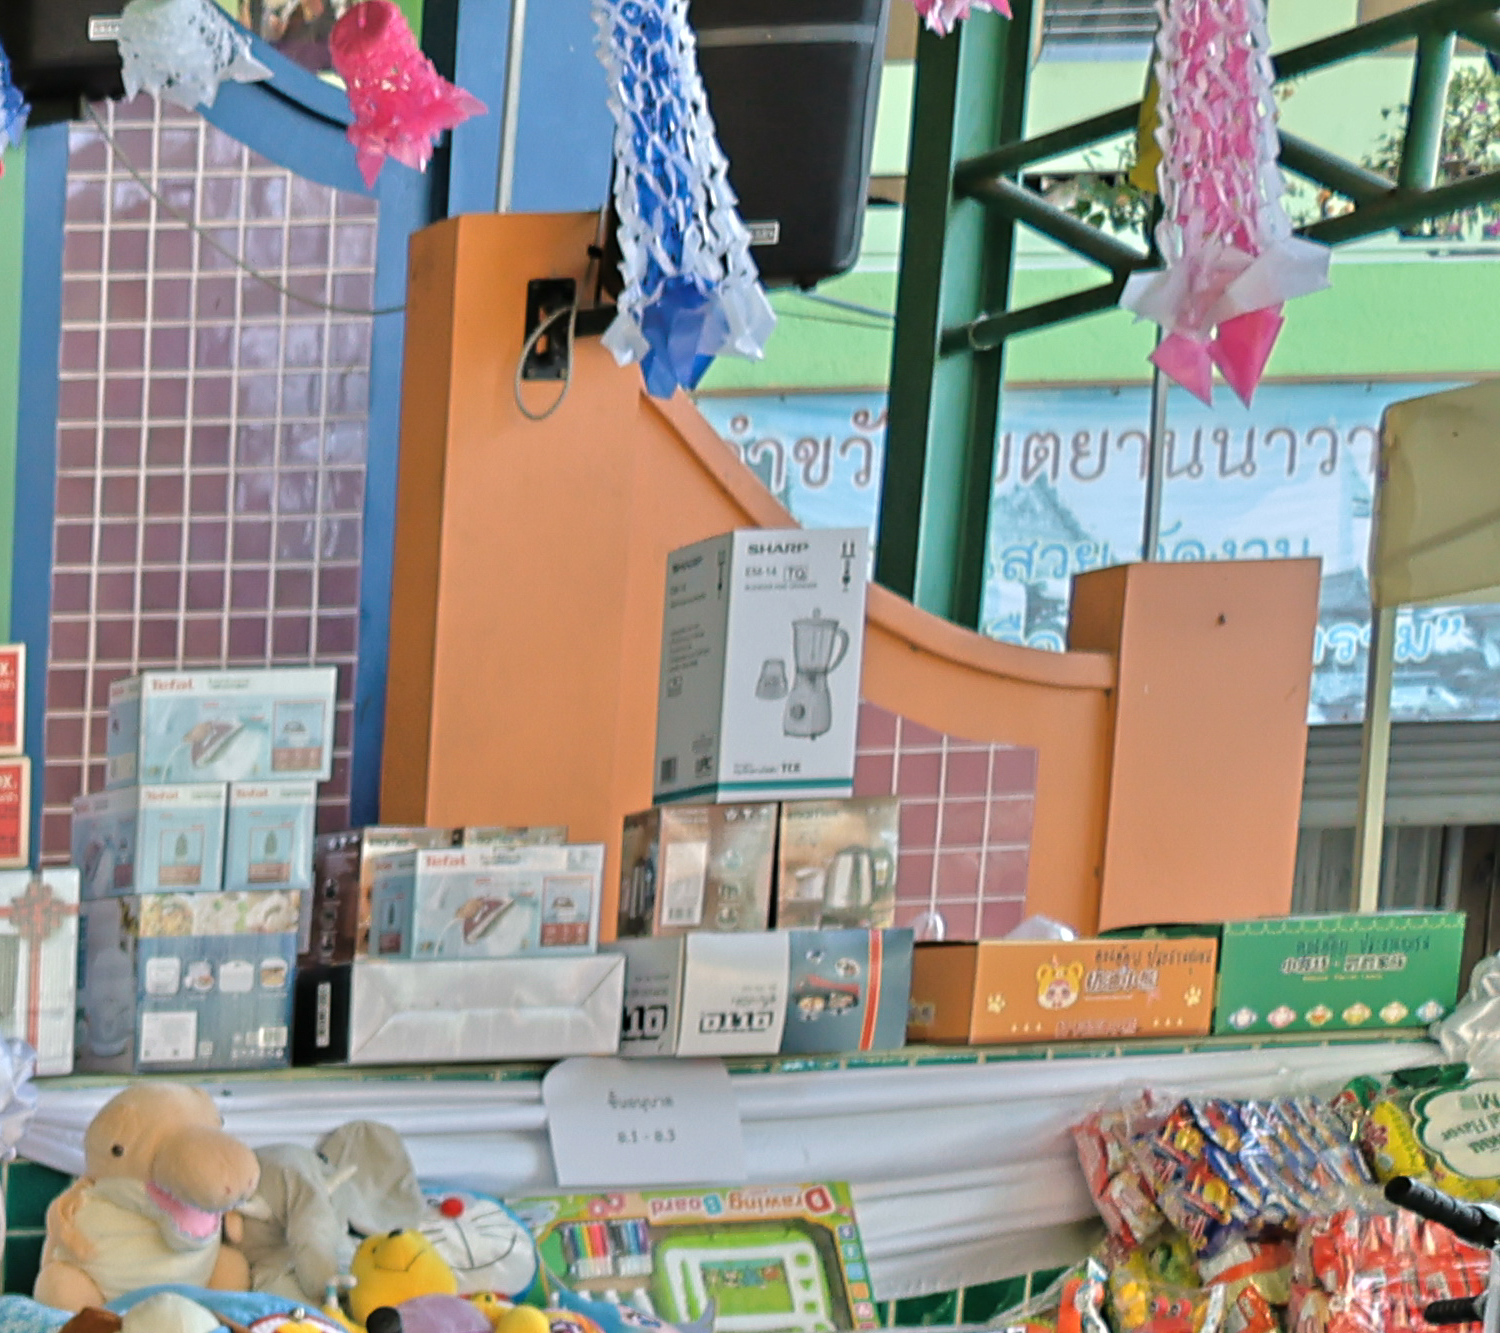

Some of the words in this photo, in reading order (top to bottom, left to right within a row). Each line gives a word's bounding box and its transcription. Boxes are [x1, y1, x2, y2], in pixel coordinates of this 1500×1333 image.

[747, 542, 810, 555] SHARP
[650, 1192, 723, 1217] Board
[727, 1184, 835, 1214] Drawing
